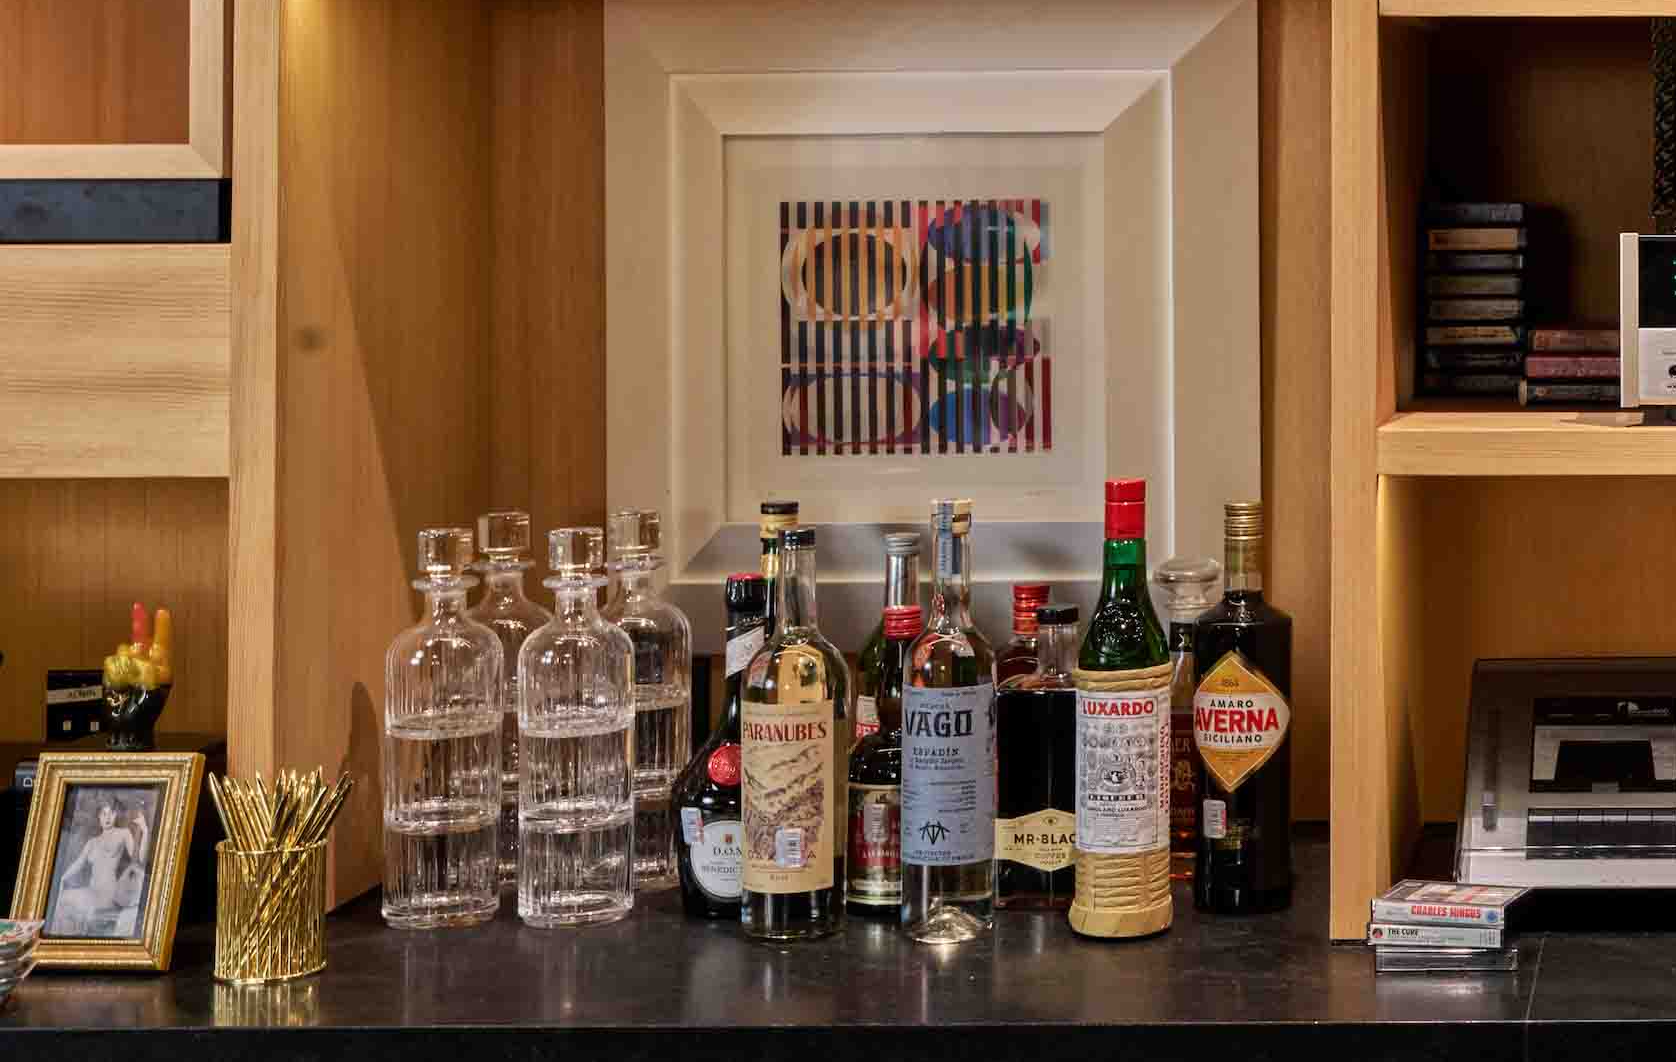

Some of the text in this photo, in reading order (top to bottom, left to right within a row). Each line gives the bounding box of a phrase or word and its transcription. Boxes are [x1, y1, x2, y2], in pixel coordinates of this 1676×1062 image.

[1082, 700, 1155, 716] LUXARDO
[1210, 699, 1254, 708] AMARO
[904, 709, 974, 738] VAGO
[1195, 707, 1280, 734] AVERNA
[743, 721, 828, 742] PARANUBES
[1203, 733, 1264, 744] SICILIANO
[1014, 833, 1076, 845] MR·BLAC
[1410, 905, 1482, 919] CHARLES MINGUS
